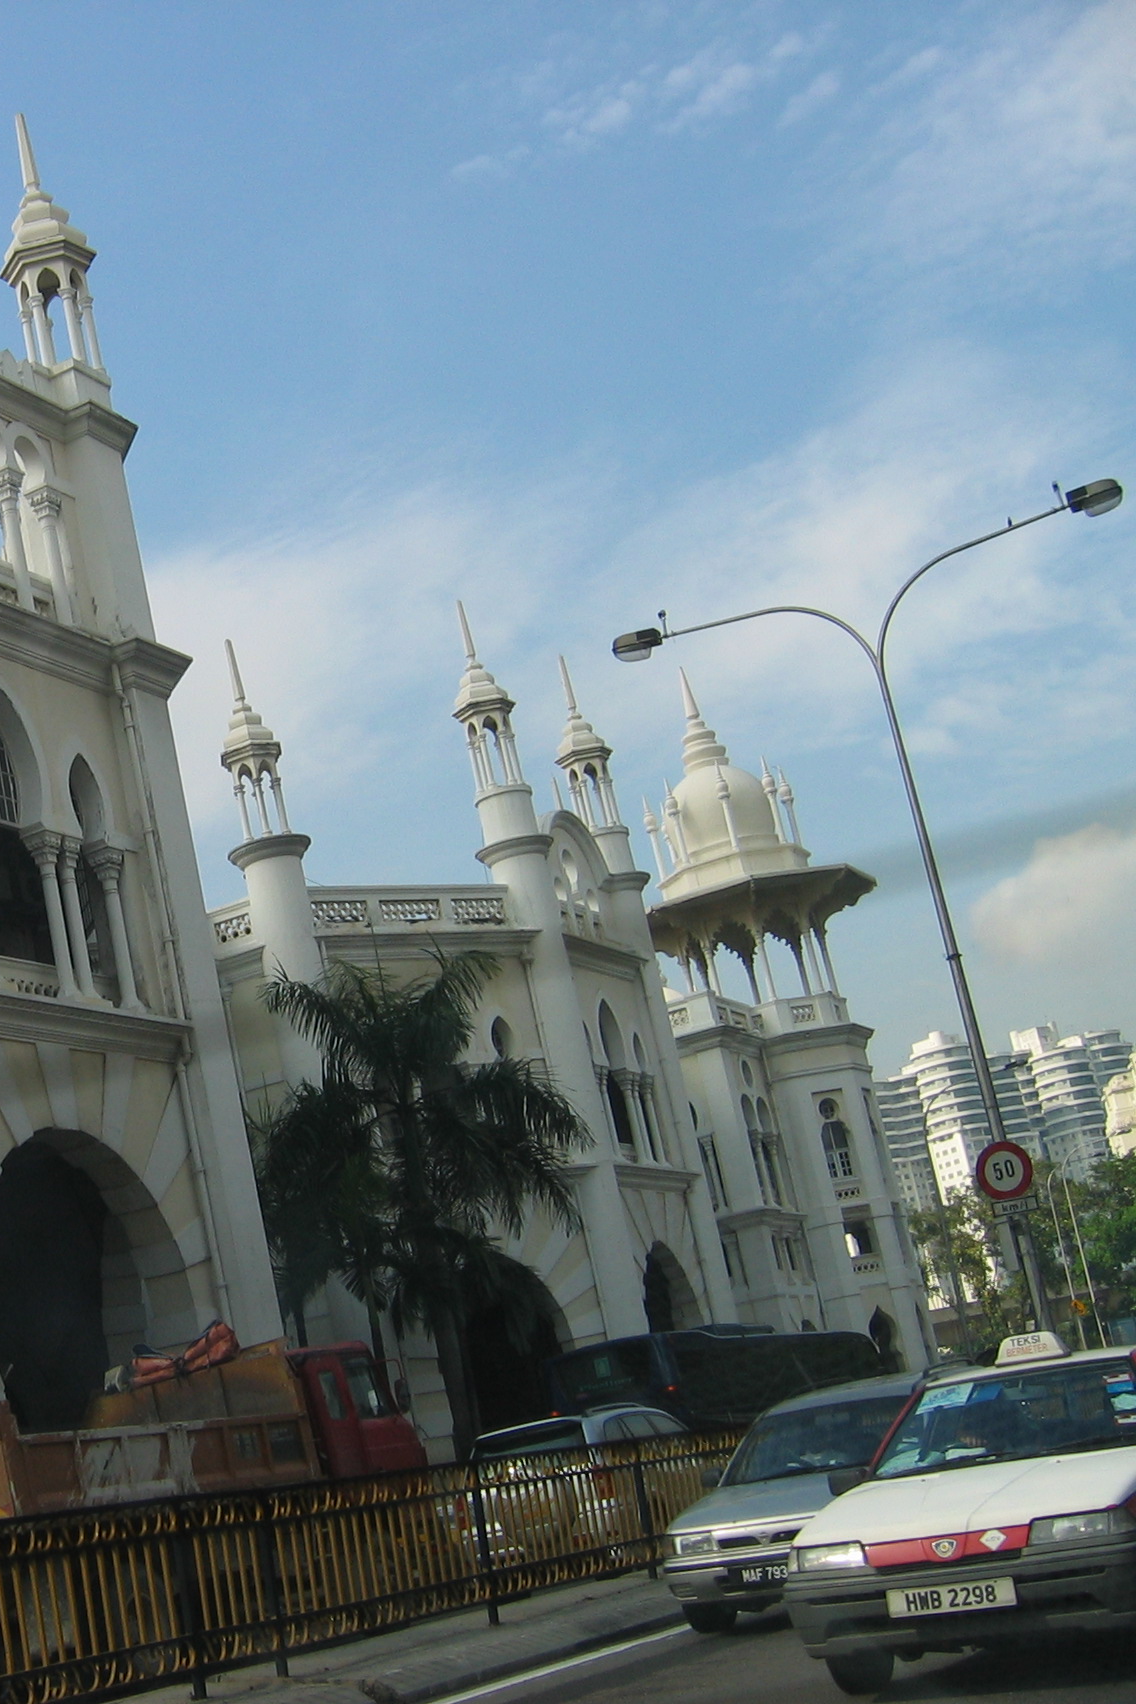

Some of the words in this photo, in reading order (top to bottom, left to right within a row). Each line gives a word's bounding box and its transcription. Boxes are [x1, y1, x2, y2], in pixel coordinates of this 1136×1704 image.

[993, 1160, 1015, 1181] 50
[1010, 1334, 1041, 1347] TEKSI
[1007, 1343, 1048, 1357] BERMETER
[742, 1568, 763, 1582] MAF
[905, 1590, 942, 1611] HWB
[947, 1584, 996, 1607] 2298
